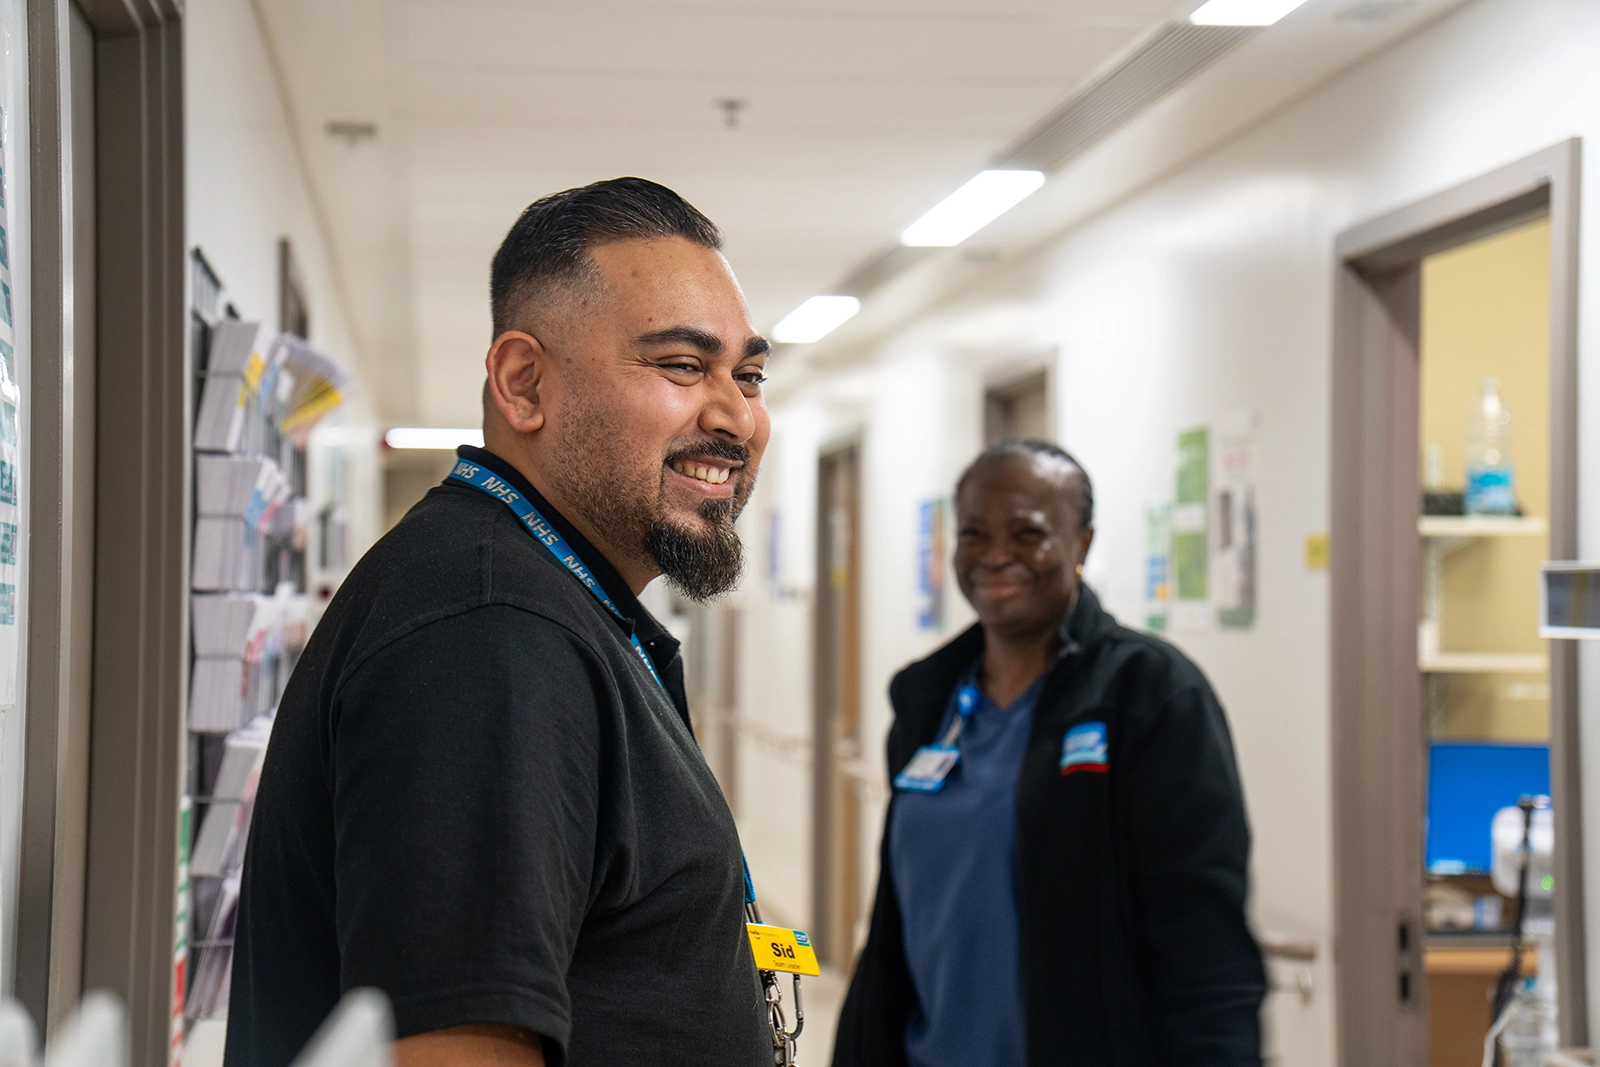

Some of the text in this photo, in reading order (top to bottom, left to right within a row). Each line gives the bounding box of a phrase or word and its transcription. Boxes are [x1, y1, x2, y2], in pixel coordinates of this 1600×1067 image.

[481, 476, 519, 504] NHS
[522, 511, 559, 546] NHS
[563, 555, 595, 589] NHS
[770, 942, 796, 959] Sid
